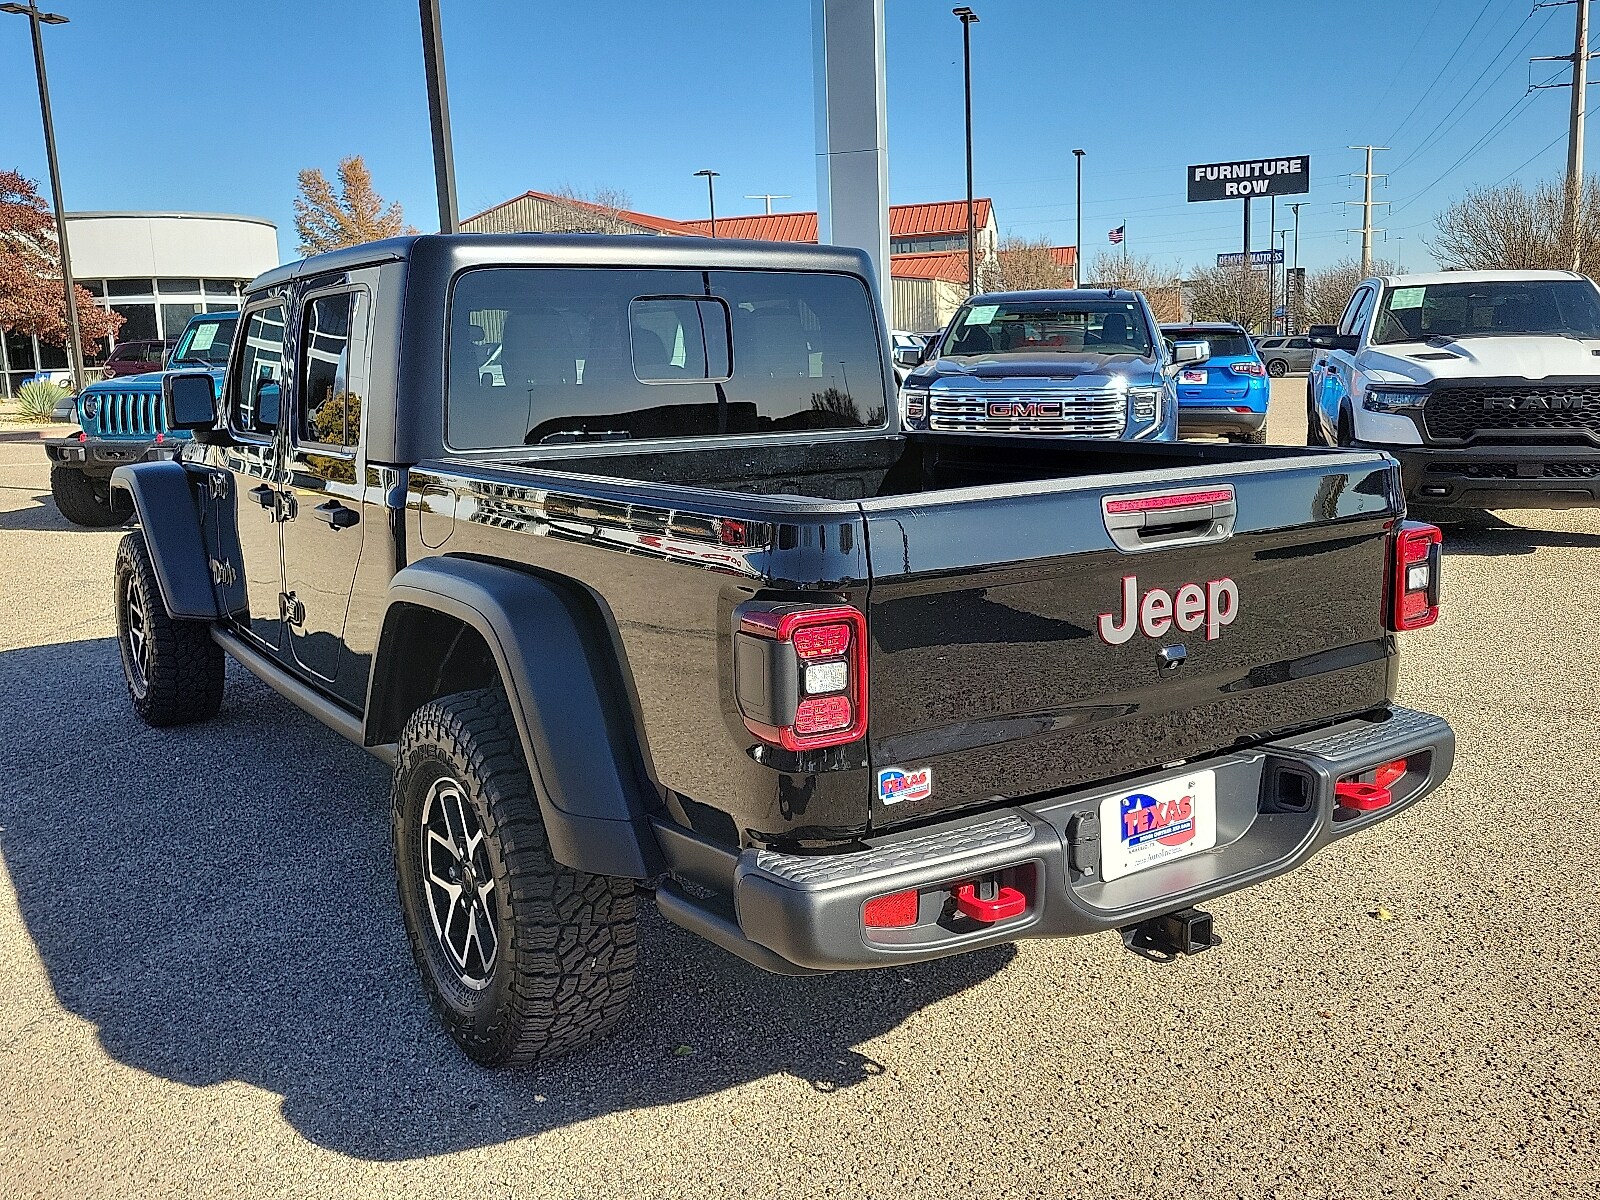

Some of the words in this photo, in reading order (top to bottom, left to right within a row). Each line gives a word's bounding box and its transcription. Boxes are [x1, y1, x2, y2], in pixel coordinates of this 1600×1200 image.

[1195, 159, 1302, 182] FURNITURE
[1225, 179, 1270, 196] ROW
[1249, 252, 1283, 263] MATTRSS
[988, 402, 1062, 418] GMC
[1483, 394, 1584, 411] RAM
[1097, 575, 1239, 646] Jeep
[882, 771, 927, 794] TEXAS
[1124, 795, 1192, 837] TEXAS
